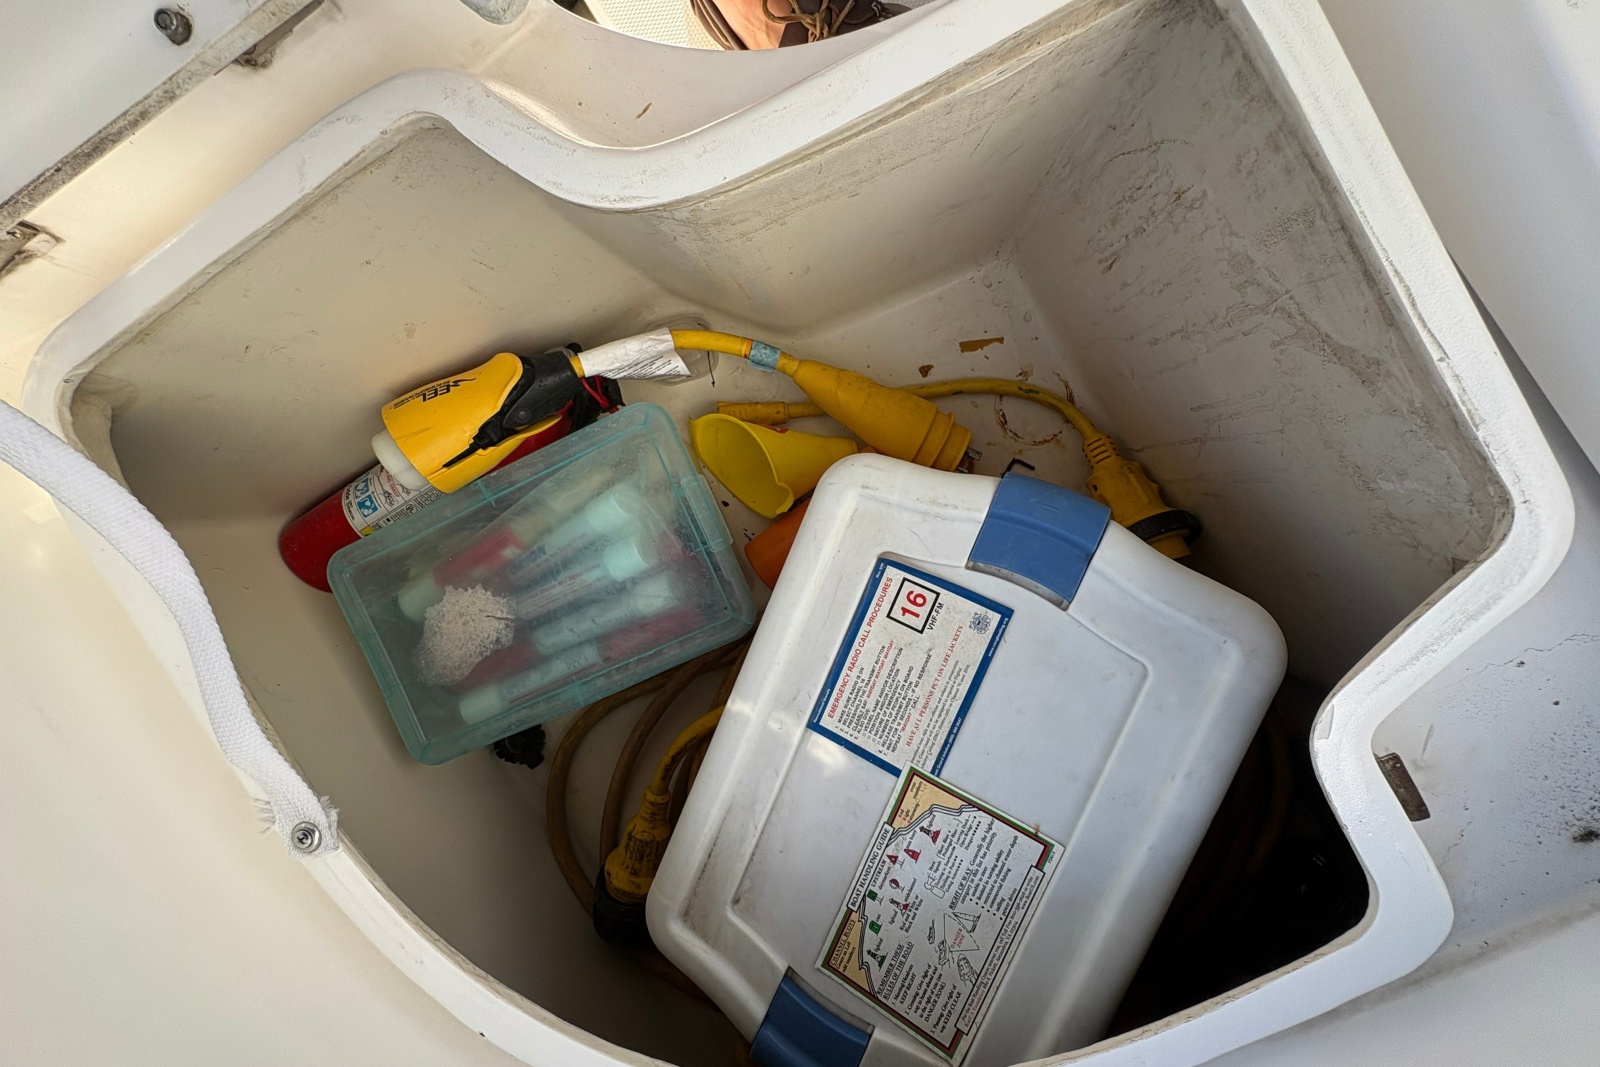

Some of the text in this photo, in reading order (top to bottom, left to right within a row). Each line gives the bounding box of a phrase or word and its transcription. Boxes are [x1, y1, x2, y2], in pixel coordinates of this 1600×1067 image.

[898, 588, 928, 622] 16
[926, 601, 944, 631] VHF-FM
[827, 576, 893, 718] EMERGENCY RADIO CALL PROCEDURES
[864, 665, 877, 689] TRANSMIT
[874, 644, 886, 665] BUTTON
[836, 708, 846, 723] MAKE
[843, 695, 851, 709] SURE
[848, 679, 858, 696] RADIO
[858, 665, 864, 674] ON
[841, 707, 852, 726] SELECT
[850, 684, 862, 707] CHANNEL
[851, 709, 864, 732] CLEARLY
[865, 678, 877, 699] MAYDAY
[874, 659, 885, 679] MAYDAY
[882, 638, 894, 659] MAYDAY
[863, 647, 903, 732] VESSEL NAME AND/OR DESCRIPTION
[868, 667, 900, 734] POSITION AND/OR LOCATION
[878, 665, 914, 740] NUMBER OF PEOPLE ON BOARD
[885, 738, 894, 751] WAIT
[891, 727, 899, 738] FOR
[898, 697, 912, 721] SECONDS
[913, 679, 920, 688] NO
[917, 653, 932, 680] RESPONSE
[905, 624, 964, 747] HAVE PERSONS PUT ON LIFE JACKETS
[856, 720, 865, 734] ALSO
[873, 679, 901, 737] NATURE OF EMERGENCY
[880, 724, 893, 748] RELEASE
[890, 700, 904, 725] TRANSMIT
[901, 680, 913, 701] BUTTON
[891, 733, 902, 753] REPEAT
[849, 826, 890, 908] BOAT HANDLING GUIDE
[870, 859, 886, 887] UPSTREAM
[948, 817, 995, 911] RIGHT OF WAY Generally the higher
[971, 867, 980, 878] this
[975, 859, 983, 868] list
[976, 884, 987, 901] limited
[986, 862, 998, 880] turning
[994, 848, 1004, 864] ability
[979, 850, 988, 860] has
[982, 834, 1019, 905] restricted to channel water depth
[959, 882, 972, 904] category
[987, 866, 1011, 909] commercial fishing
[994, 896, 1005, 912] sailing
[1000, 886, 1018, 916] power driven
[830, 918, 855, 966] CHANNEL BUOYS
[950, 927, 962, 949] DANGER
[956, 934, 965, 948] ZONE
[875, 942, 904, 996] REMEMBER THESE
[882, 940, 914, 1000] RULES OF THE ROAD
[898, 971, 917, 1004] KEEP RIGHT
[916, 978, 924, 991] Give
[921, 968, 929, 980] right
[924, 998, 938, 1022] DANGER
[938, 990, 962, 1033] way KEEP CLEAR
